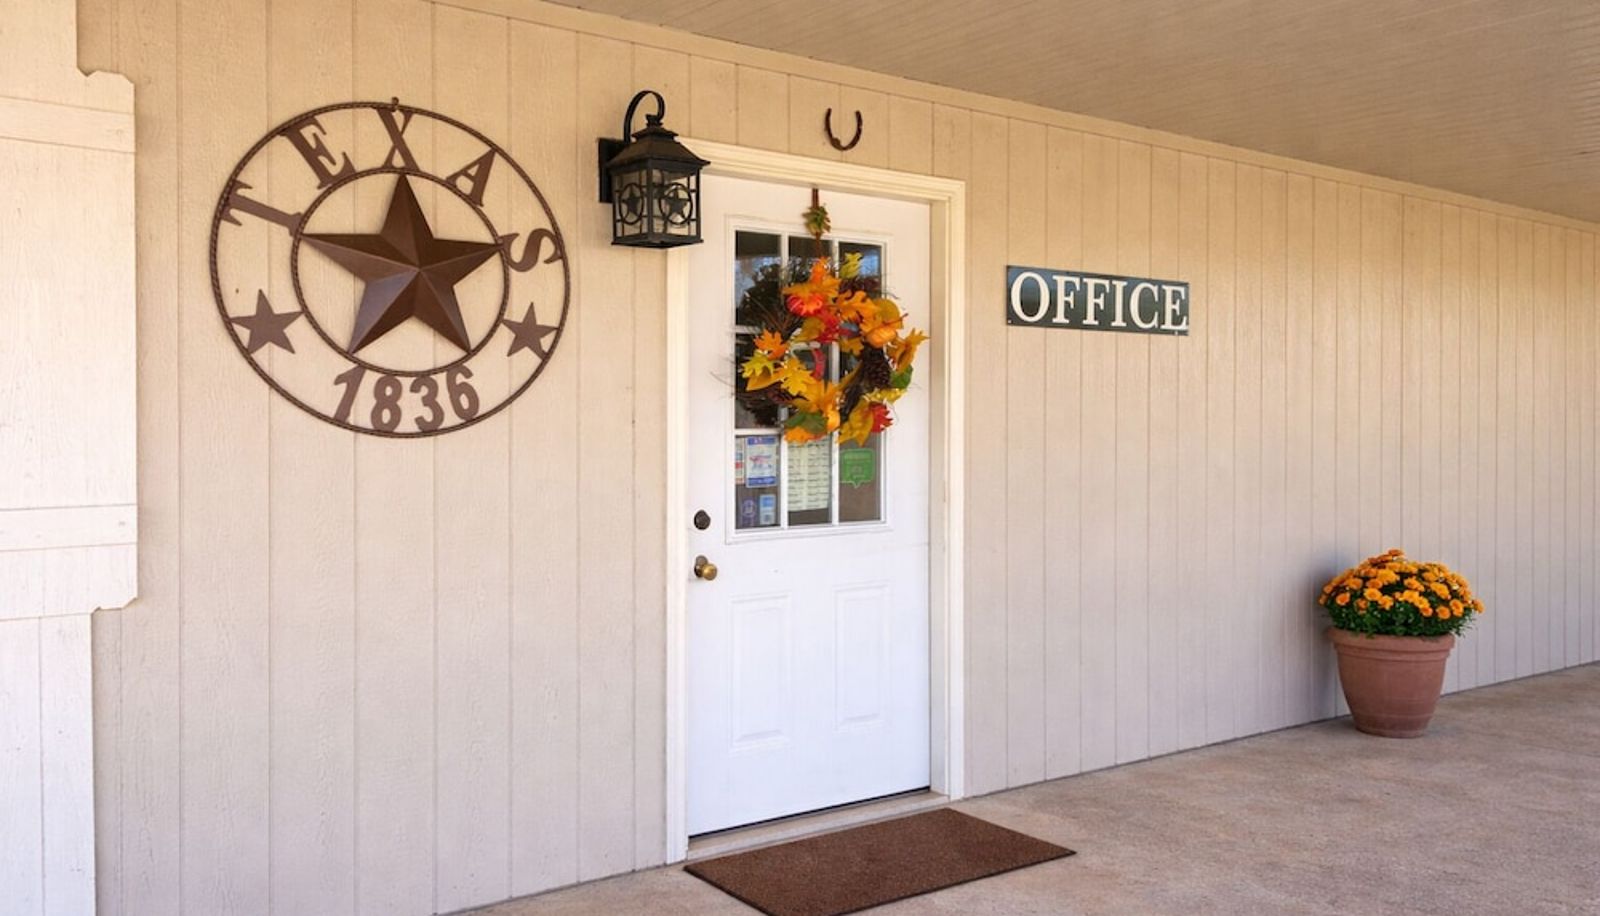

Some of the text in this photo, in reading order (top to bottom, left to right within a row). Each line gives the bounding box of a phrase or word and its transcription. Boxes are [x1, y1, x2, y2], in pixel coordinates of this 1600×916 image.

[217, 107, 563, 272] TEXAS
[1010, 271, 1189, 331] OFFICE
[333, 364, 480, 432] 1836
